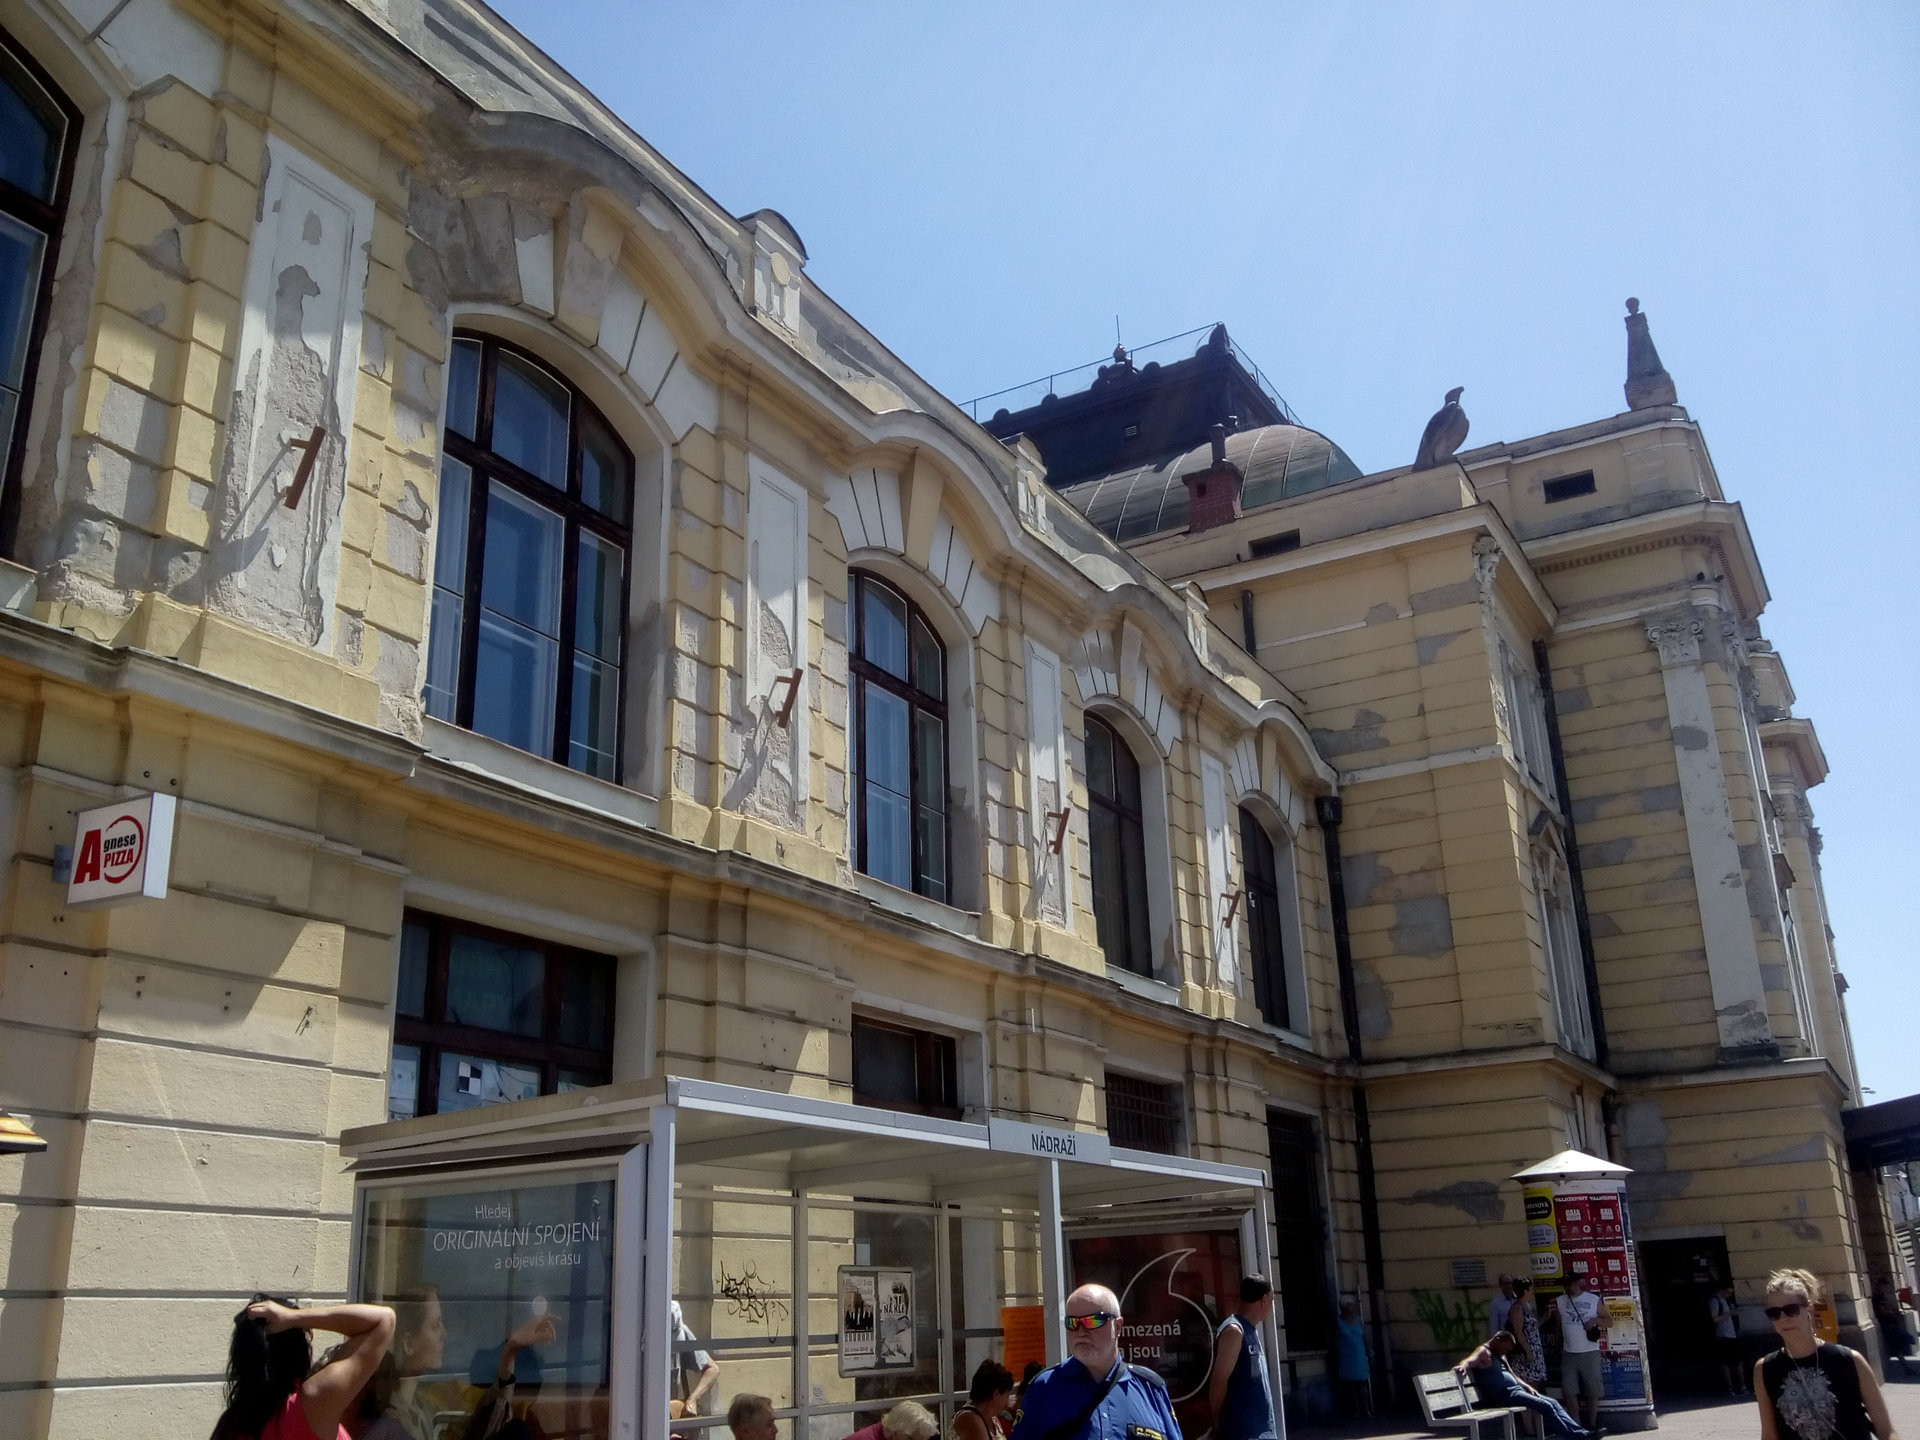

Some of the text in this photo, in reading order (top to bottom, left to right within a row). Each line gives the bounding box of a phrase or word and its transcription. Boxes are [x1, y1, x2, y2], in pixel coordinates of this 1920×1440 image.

[103, 848, 134, 868] PIZZA
[1031, 1130, 1076, 1156] NÁDRAŽÍ
[475, 1204, 511, 1220] Hledej
[433, 1216, 600, 1251] ORIGINÁLNÍ SPOJENÍ
[494, 1250, 581, 1271] a objevíš krásu
[1121, 1319, 1181, 1337] mezená
[1129, 1344, 1161, 1362] jsou
